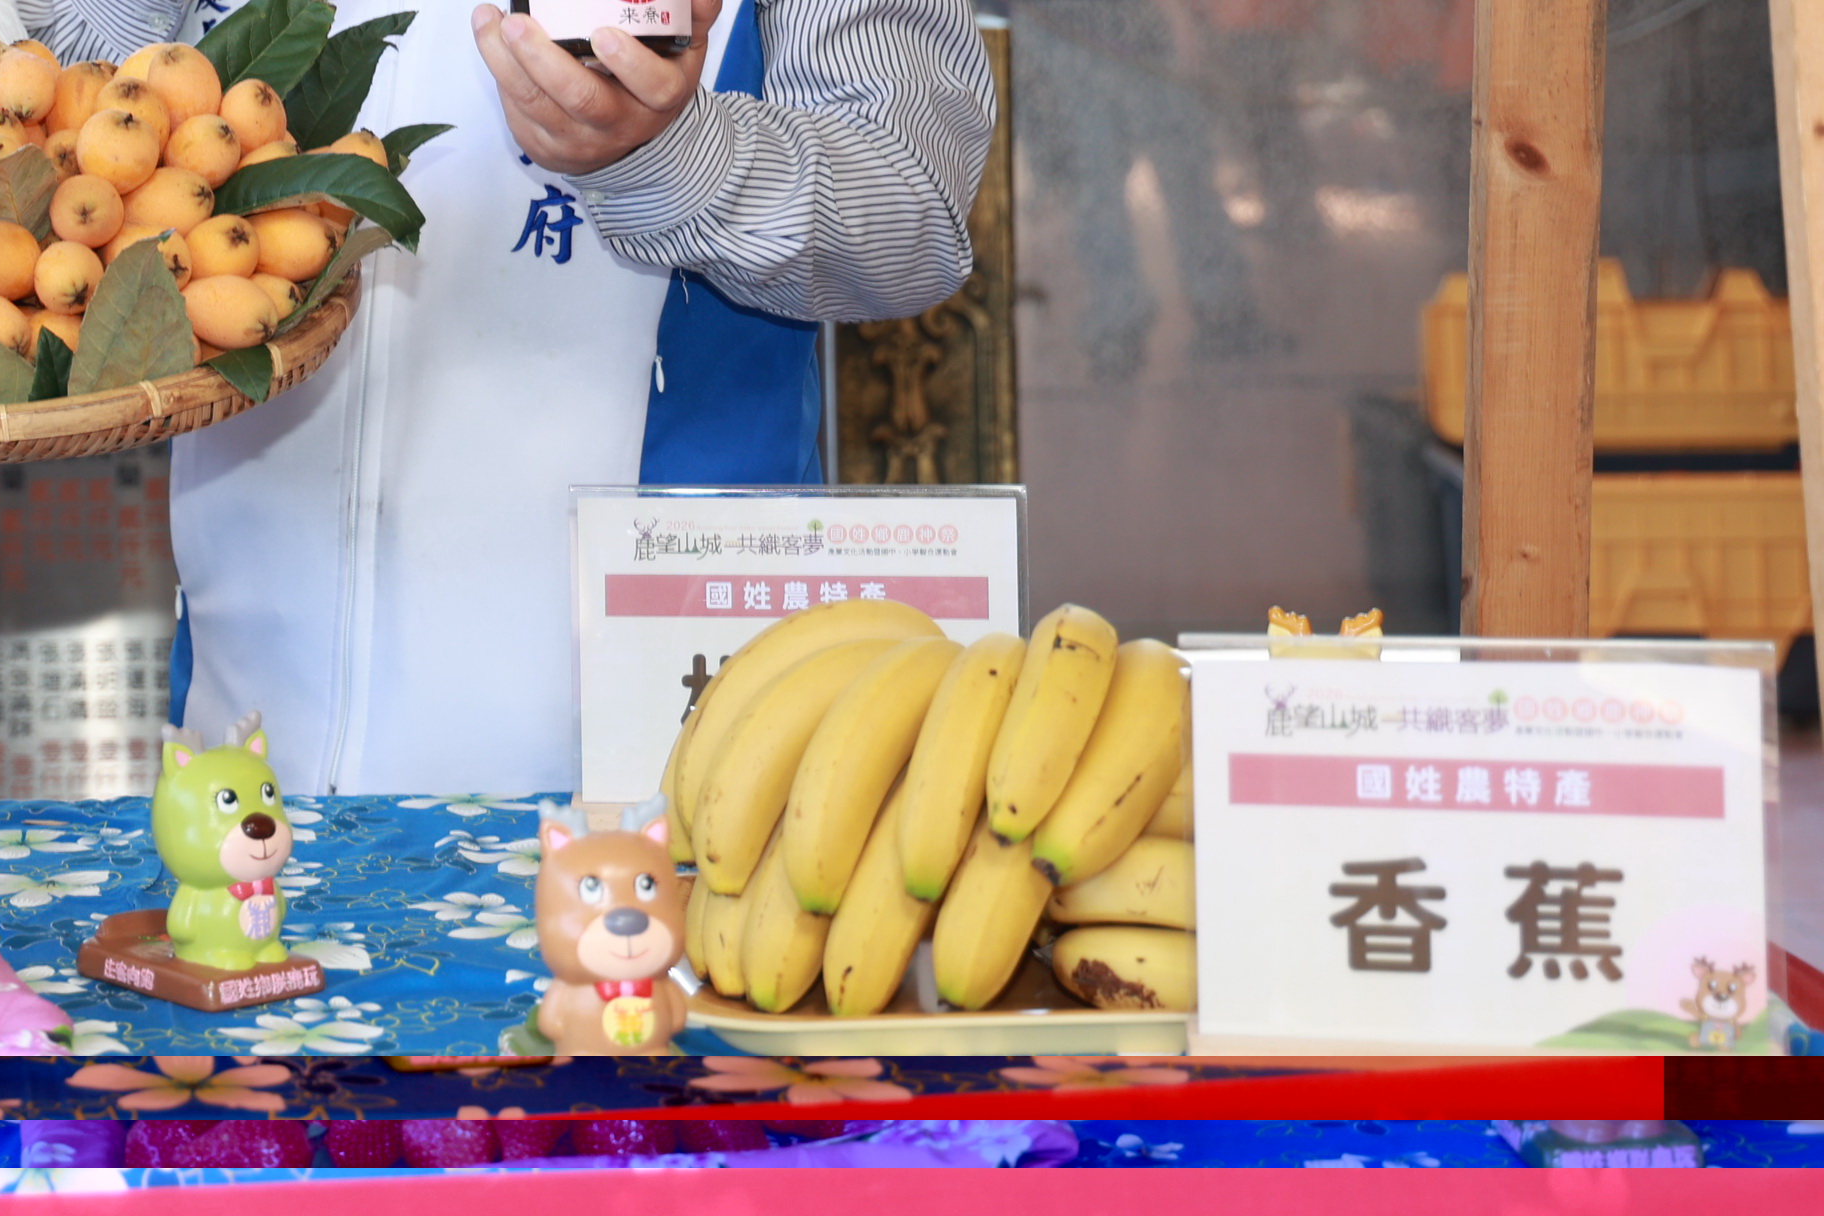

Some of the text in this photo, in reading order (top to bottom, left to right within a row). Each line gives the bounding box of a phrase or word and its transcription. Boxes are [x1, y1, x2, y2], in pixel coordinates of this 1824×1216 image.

[511, 153, 584, 264] 府
[1356, 764, 1592, 807] 國姓農特產
[1328, 857, 1625, 984] 香蕉
